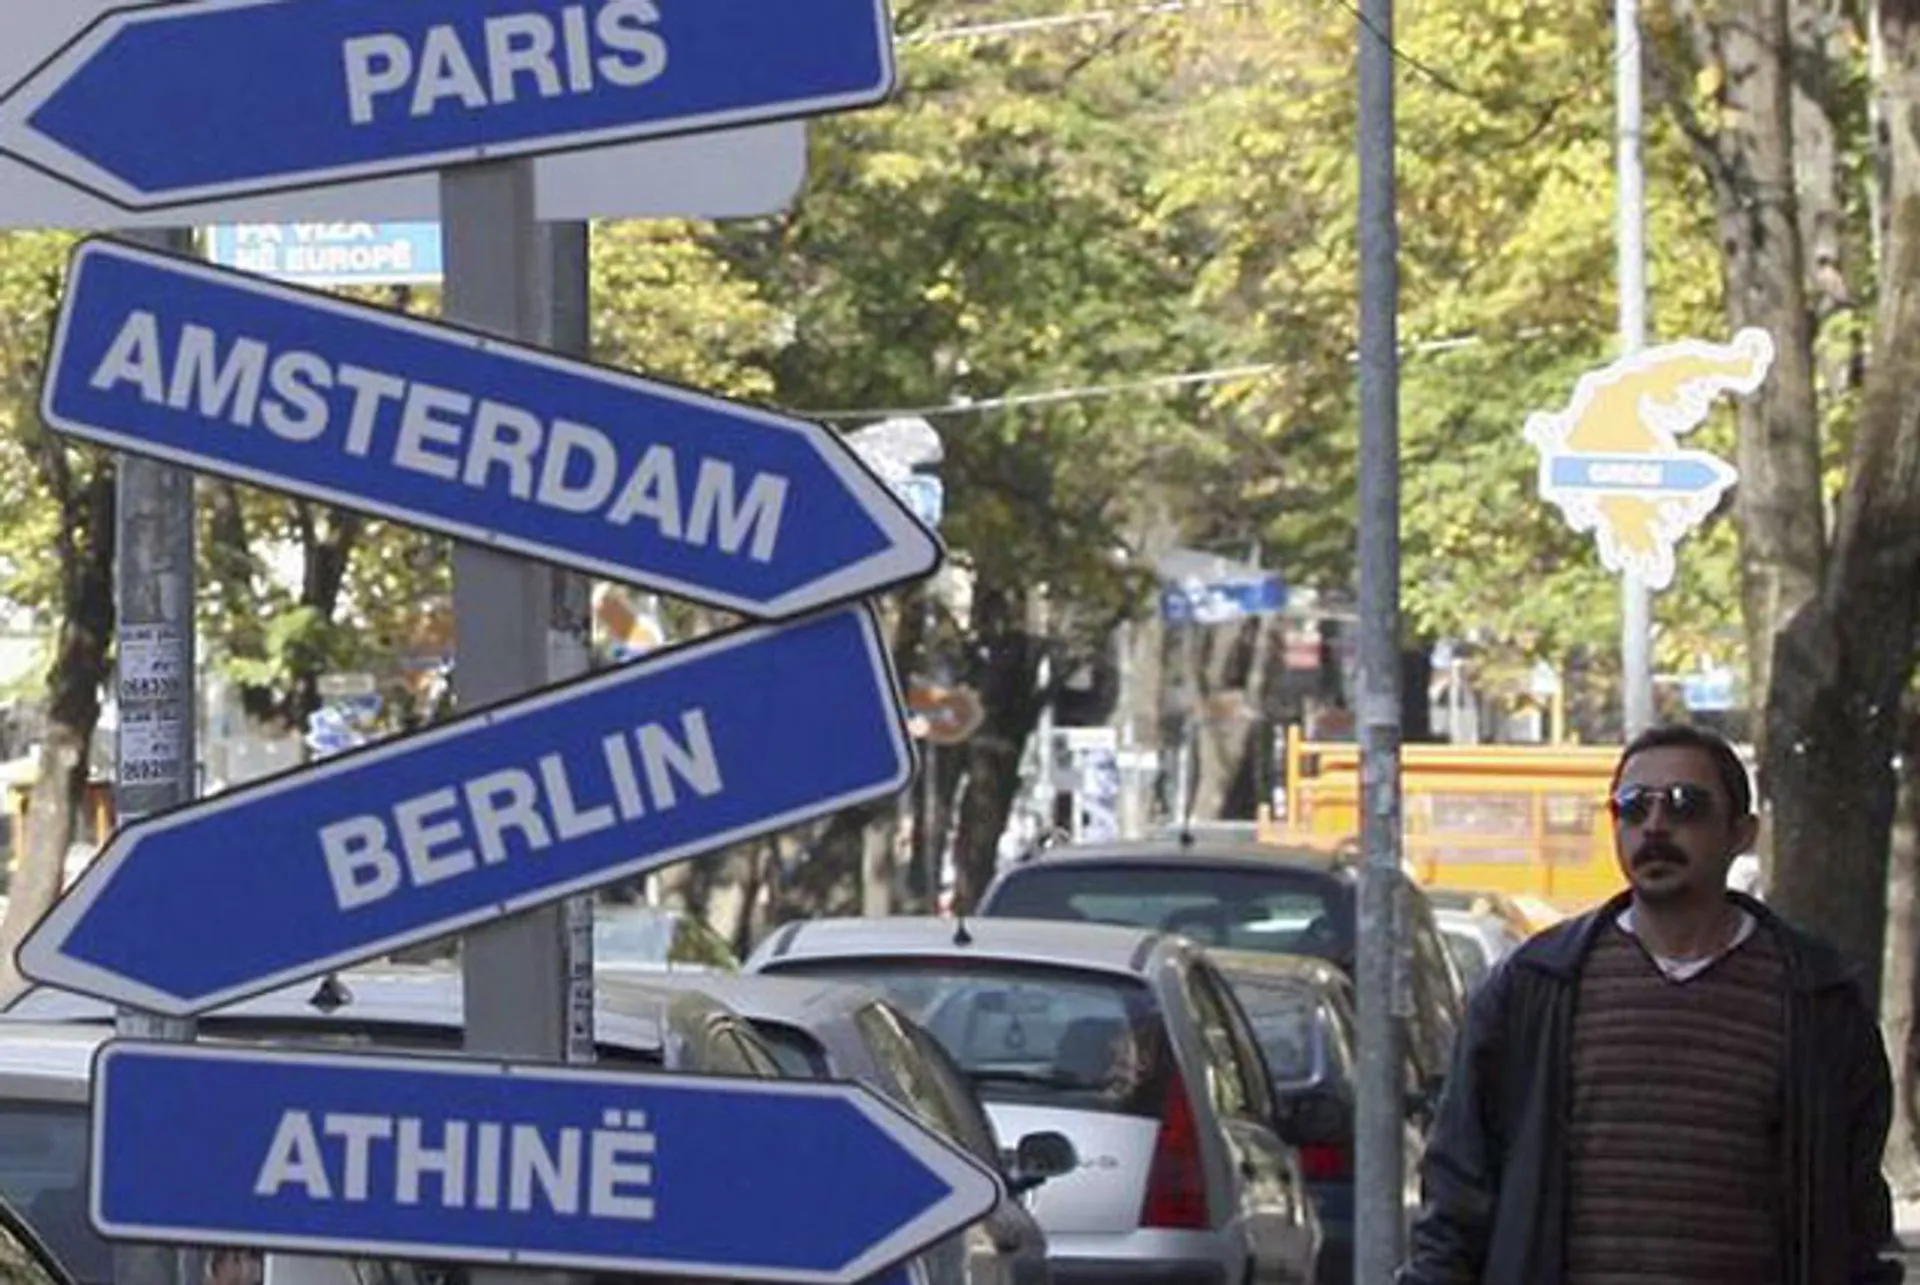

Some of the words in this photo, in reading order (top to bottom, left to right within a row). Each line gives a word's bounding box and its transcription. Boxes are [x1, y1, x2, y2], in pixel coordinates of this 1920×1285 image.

[345, 0, 667, 123] PARIS
[91, 311, 787, 562] AMSTERDAM
[319, 709, 722, 909] BERLIN
[255, 1110, 655, 1219] ATHINË
